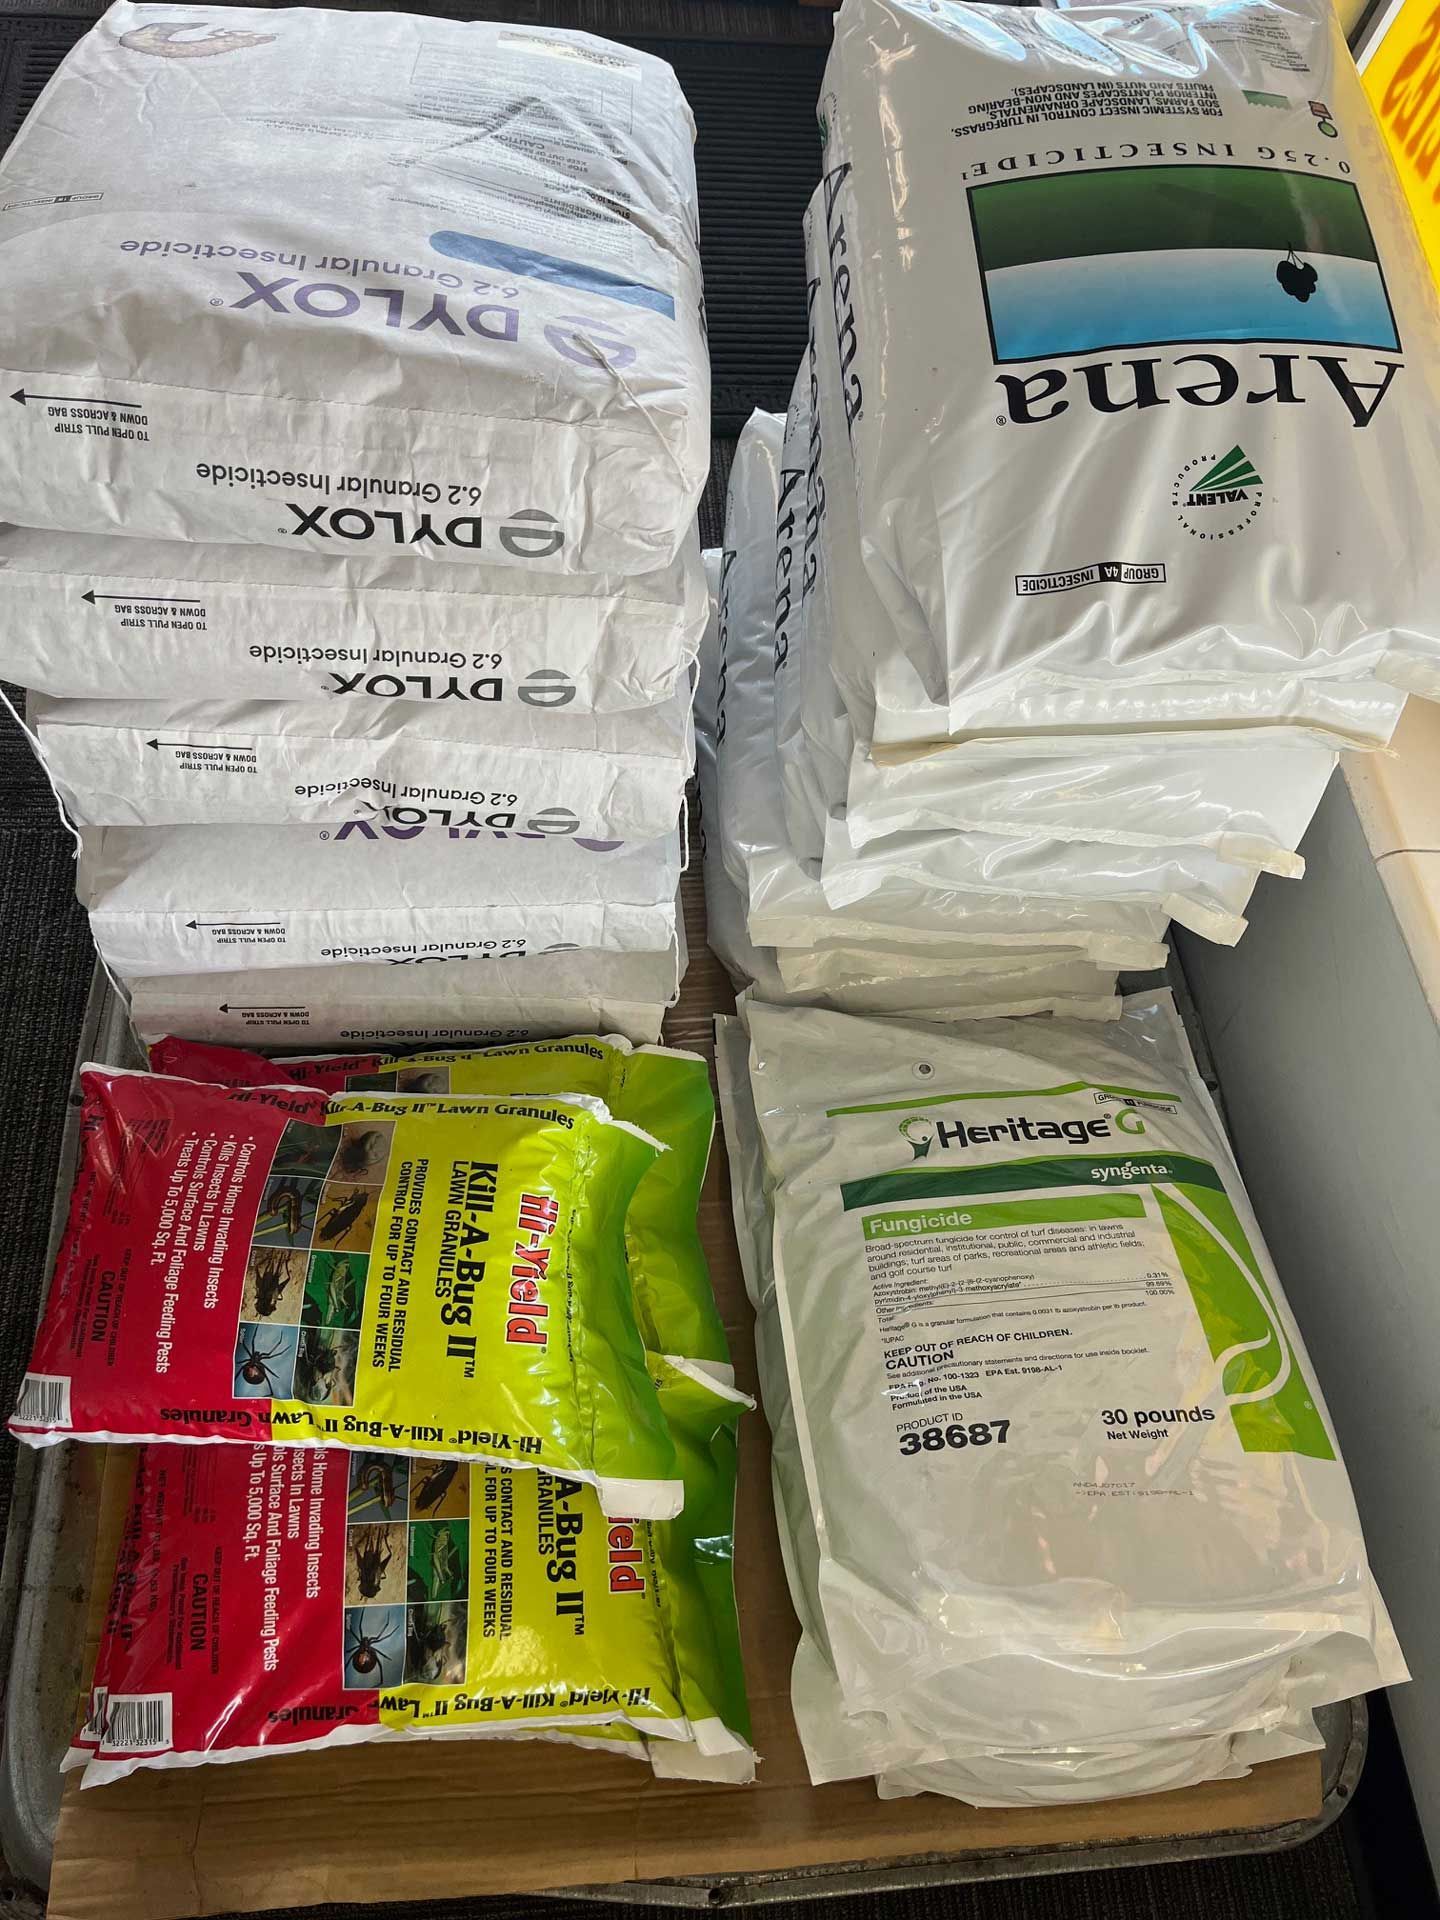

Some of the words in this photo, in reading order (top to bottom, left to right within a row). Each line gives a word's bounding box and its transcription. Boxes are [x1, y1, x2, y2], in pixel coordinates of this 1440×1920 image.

[1011, 82, 1094, 96] LANDSCAPES).
[1054, 91, 1080, 100] AND
[1082, 89, 1164, 99] PLANTSCAPES
[1097, 81, 1113, 90] (IN
[1116, 81, 1147, 90] NUTS
[1149, 82, 1173, 90] AND
[1166, 90, 1217, 100] INTERIOR
[1176, 83, 1214, 91] FRUITS
[967, 94, 1052, 115] NON-BEARING
[988, 101, 1079, 120] ORNAMENTALS,
[1079, 97, 1150, 108] LANDSCAPE
[1142, 105, 1200, 116] SYSTEMIC
[1151, 96, 1194, 106] FARMS,
[1197, 99, 1220, 108] SOD
[1026, 113, 1040, 124] IN
[1041, 108, 1096, 121] CONTROL
[1099, 106, 1140, 117] INSECT
[1202, 108, 1223, 117] FOR
[951, 116, 1025, 137] TURFGRASS,
[1257, 147, 1351, 174] 0.25G
[119, 238, 306, 274] Insecticide
[314, 255, 463, 292] Granular
[472, 279, 519, 301] 6.2
[47, 406, 68, 418] BAG
[70, 408, 110, 421] ACROSS
[110, 411, 118, 422] &
[120, 413, 148, 426] DOWN
[54, 423, 83, 435] STRIP
[85, 424, 110, 437] PULL
[111, 427, 135, 440] OPEN
[137, 430, 151, 442] TO
[193, 462, 328, 496] Insecticide
[334, 475, 440, 504] Granular
[446, 485, 481, 506] 6.2
[1177, 491, 1263, 541] PROFESSIONAL
[1022, 569, 1094, 592] INSECTICIDE
[1102, 564, 1120, 579] 4A
[1123, 567, 1160, 580] GROUP
[114, 605, 133, 614] BAG
[134, 605, 169, 615] ACROSS
[170, 607, 178, 617] &
[180, 608, 207, 618] DOWN
[120, 618, 146, 628] STRIP
[147, 620, 169, 629] PULL
[170, 621, 194, 630] OPEN
[196, 622, 208, 631] TO
[247, 644, 367, 666] Insecticide
[371, 648, 466, 669] Granular
[471, 653, 503, 670] 6.2
[292, 778, 396, 800] Insecticide
[398, 785, 486, 805] Granular
[489, 792, 518, 807] 6.2
[318, 944, 415, 960] Insecticide
[419, 942, 498, 956] Granular
[501, 938, 526, 951] 6.2
[339, 1028, 431, 1042] Insecticide
[433, 1027, 501, 1041] Granular
[534, 1043, 603, 1060] Granules
[436, 1103, 489, 1114] Lawn
[494, 1104, 574, 1130] Granules
[1115, 1107, 1147, 1135] G
[177, 1138, 200, 1168] Treats
[193, 1139, 219, 1180] Controls
[218, 1140, 239, 1162] Kills
[230, 1142, 257, 1183] Controls
[170, 1169, 189, 1183] Up
[206, 1162, 229, 1200] Insects
[447, 1160, 470, 1205] LAWN
[1091, 1164, 1171, 1183] syngenta
[167, 1184, 185, 1198] To
[392, 1160, 413, 1213] CONTROL
[408, 1158, 429, 1215] PROVIDES
[179, 1181, 205, 1221] Surface
[204, 1202, 219, 1213] In
[222, 1184, 243, 1215] Home
[156, 1198, 178, 1229] 5,000
[869, 1210, 972, 1236] Fungicide
[174, 1223, 193, 1246] And
[193, 1214, 214, 1252] Lawns
[388, 1215, 403, 1241] FOR
[149, 1231, 170, 1250] Sq.
[207, 1216, 234, 1265] Invading
[399, 1219, 419, 1275] CONTACT
[440, 1161, 498, 1327] Kill-A-Bug
[149, 1251, 166, 1267] Ft.
[386, 1243, 399, 1261] UP
[435, 1209, 462, 1298] GRANULES
[164, 1249, 188, 1291] Foliage
[382, 1264, 396, 1282] TO
[870, 1271, 887, 1281] and
[888, 1269, 905, 1279] golf
[906, 1266, 936, 1275] course
[938, 1263, 952, 1272] turf
[202, 1266, 225, 1309] Insects
[396, 1279, 410, 1306] AND
[90, 1269, 117, 1343] CAUTION
[376, 1284, 393, 1319] FOUR
[156, 1292, 181, 1338] Feeding
[372, 1322, 389, 1368] WEEKS
[388, 1309, 408, 1373] RESIDUAL
[884, 1346, 912, 1359] KEEP
[914, 1343, 937, 1354] OUT
[938, 1340, 954, 1350] OF
[956, 1334, 993, 1347] REACH
[997, 1332, 1012, 1343] OF
[1013, 1327, 1072, 1342] CHILDREN.
[154, 1340, 174, 1374] Pests
[885, 1349, 954, 1370] CAUTION
[160, 1408, 252, 1429] Granules
[257, 1411, 314, 1426] Lawn
[896, 1414, 944, 1433] PRODUCT
[947, 1411, 963, 1423] ID
[1101, 1408, 1129, 1426] 30
[1133, 1405, 1216, 1427] pounds
[343, 1415, 444, 1443] Kill-A-Bug
[899, 1420, 1011, 1457] 38687
[1107, 1428, 1127, 1441] Net
[1129, 1426, 1170, 1441] Weight
[484, 1476, 497, 1502] FOR
[484, 1505, 497, 1523] UP
[500, 1477, 513, 1535] CONTACT
[484, 1527, 497, 1544] TO
[500, 1539, 512, 1568] AND
[483, 1547, 497, 1585] FOUR
[189, 1572, 208, 1653] CAUTION
[483, 1587, 497, 1638] WEEKS
[499, 1571, 513, 1641] RESIDUAL
[454, 1693, 556, 1713] Kill-A-Bug
